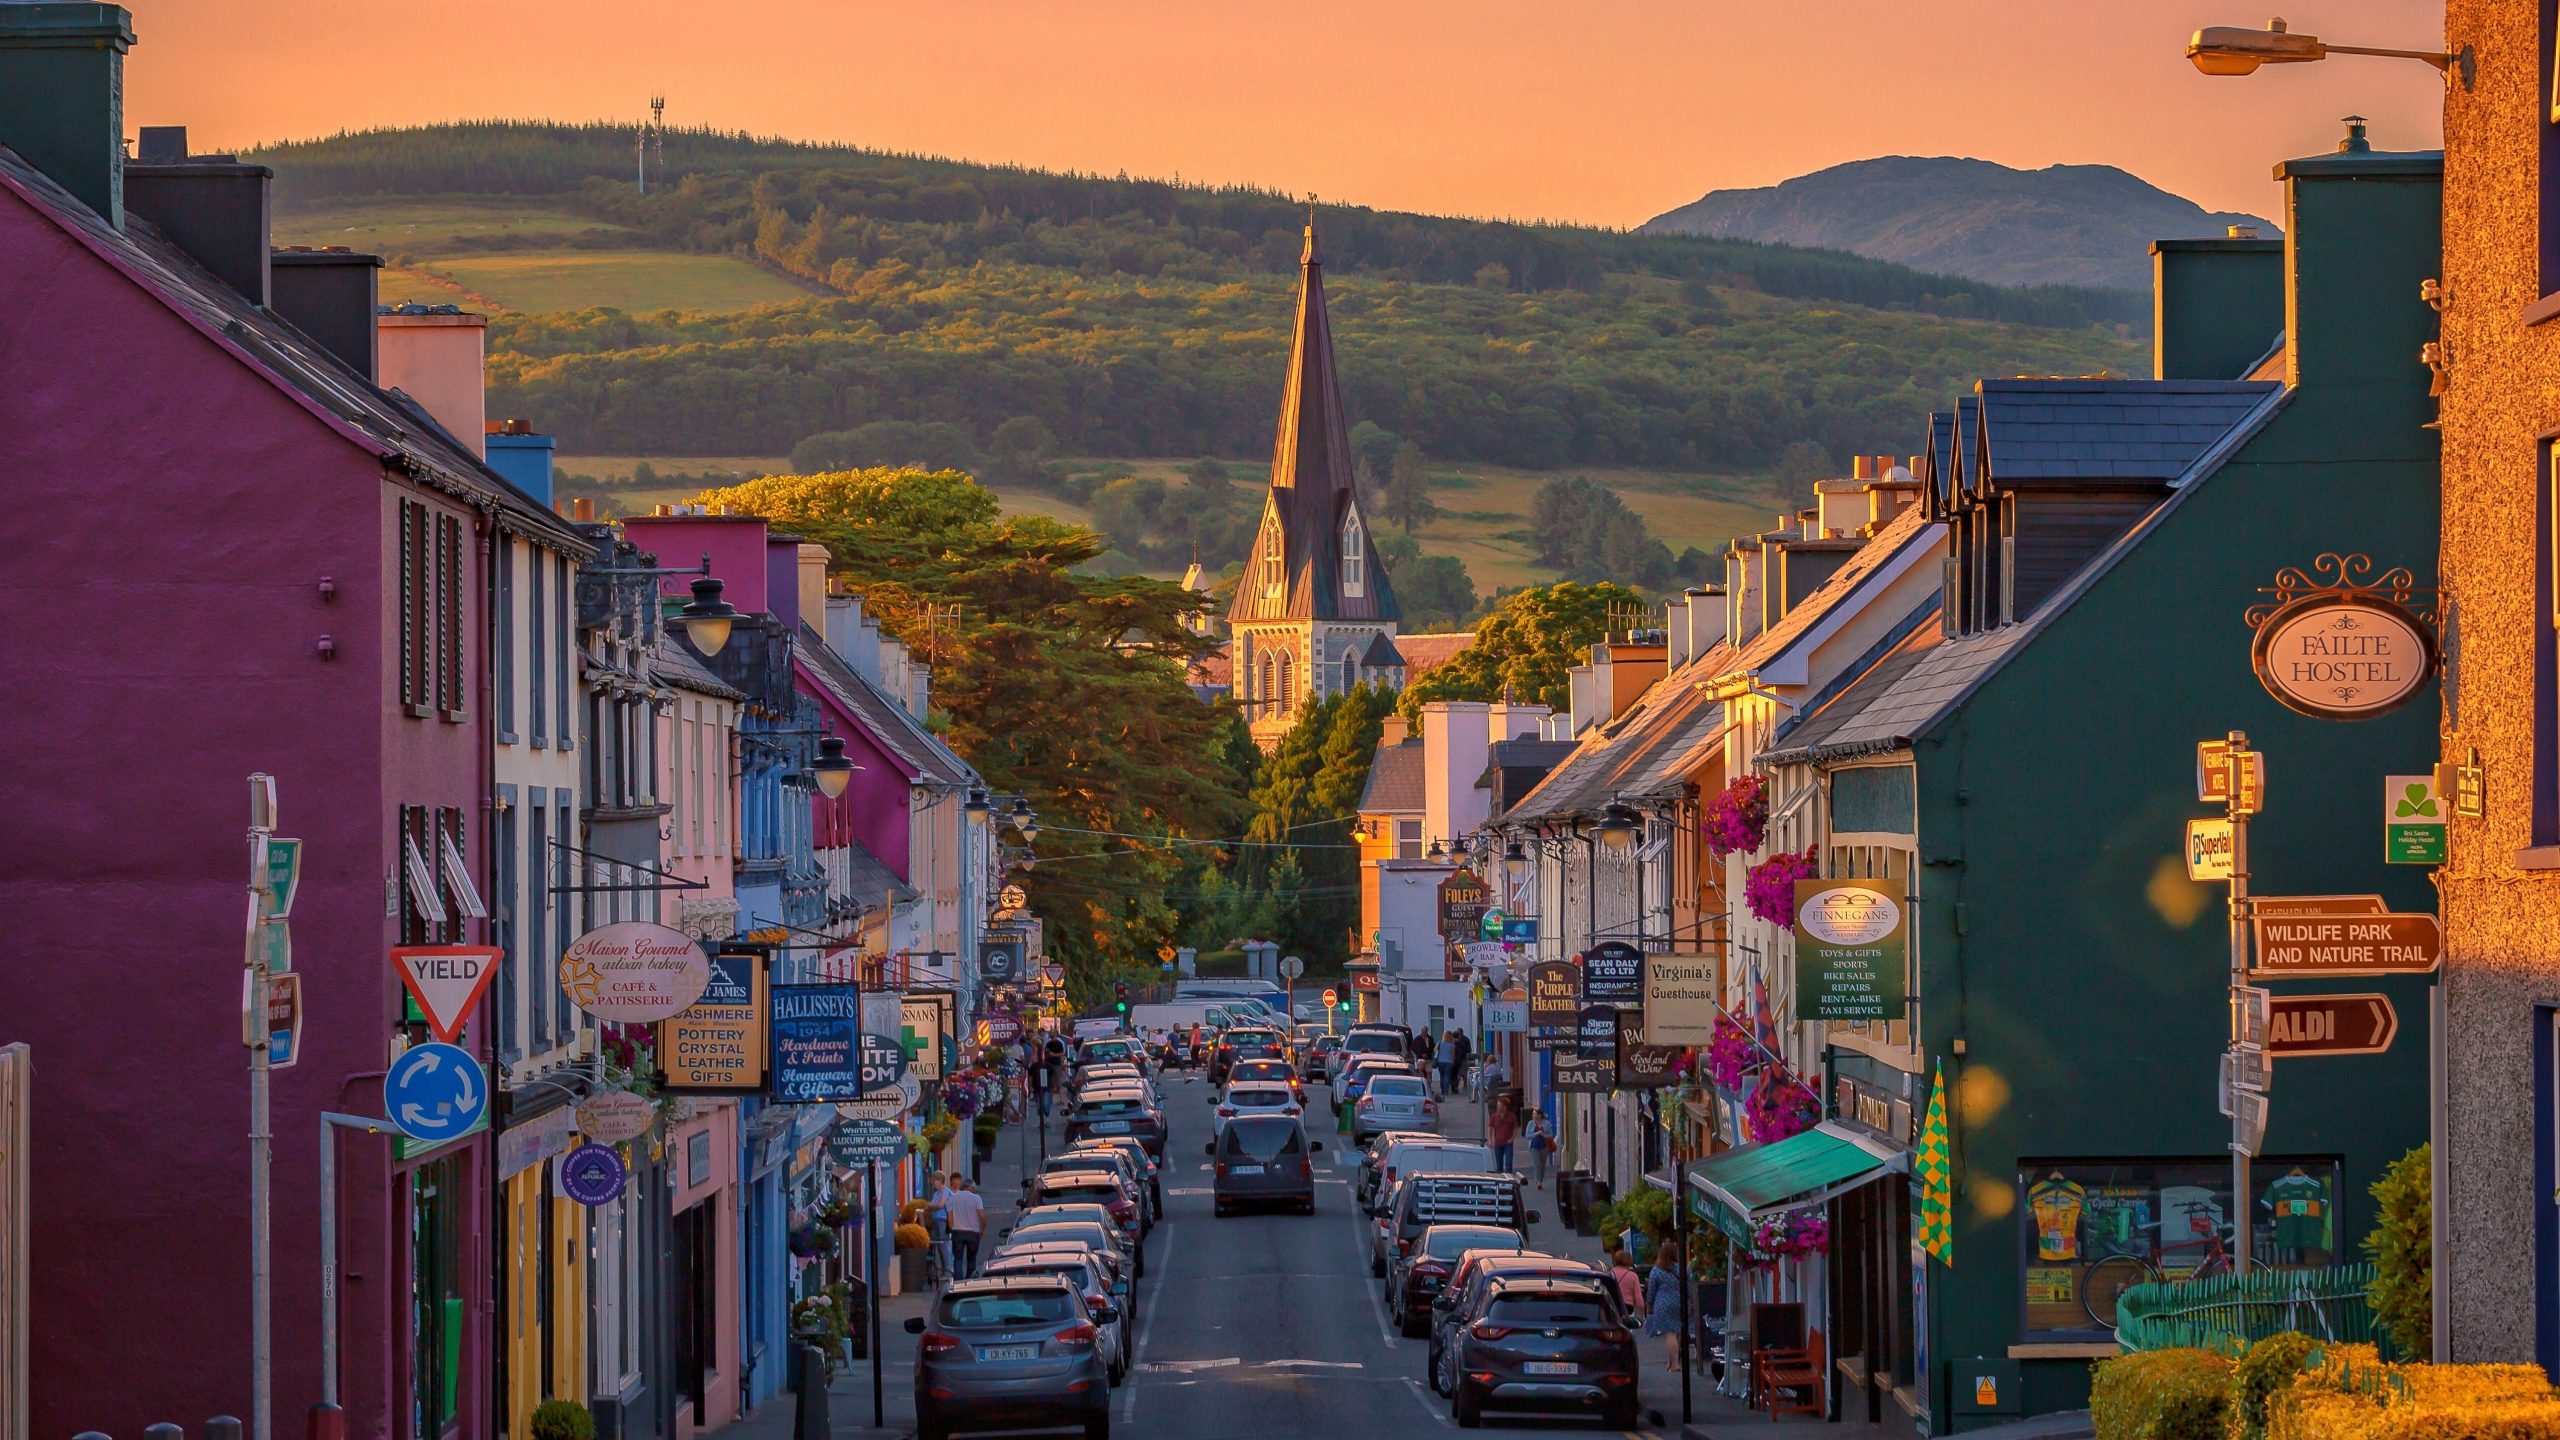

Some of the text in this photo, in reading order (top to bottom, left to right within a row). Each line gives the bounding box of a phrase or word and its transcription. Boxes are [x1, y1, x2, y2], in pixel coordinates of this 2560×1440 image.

[2302, 630, 2391, 655] FÁILTE
[2292, 662, 2400, 682] HOSTEL
[1445, 888, 1481, 903] FOLEYS
[1812, 911, 1888, 920] FINNEGANS
[2266, 924, 2392, 941] WILDLIFE PARK
[574, 938, 692, 960] Maison Gourmet
[2267, 946, 2428, 964] AND NATURE TRAIL
[414, 960, 478, 980] YIELD
[602, 957, 688, 974] artisan bakery
[1547, 971, 1563, 982] The
[1652, 964, 1712, 982] Virginia's
[612, 980, 657, 992] CAFÉ &
[713, 986, 746, 997] JAMES
[1536, 979, 1574, 996] PURPLE
[1652, 987, 1711, 999] Guesthouse
[597, 996, 673, 1005] PATISSERIE
[774, 994, 854, 1020] HALLISSEY'S
[1532, 997, 1576, 1011] HEATHER
[1587, 1019, 1614, 1028] Sherry
[2270, 1010, 2334, 1042] ALDI
[678, 1029, 745, 1040] POTTERY
[800, 1028, 830, 1037] 1954
[679, 1043, 744, 1054] CRYSTAL
[780, 1038, 849, 1051] Hardware
[678, 1057, 744, 1068] LEATHER
[787, 1051, 843, 1064] & Paints
[864, 1050, 898, 1064] ITE
[691, 1071, 733, 1082] GIFTS
[782, 1069, 853, 1082] Homeware
[862, 1067, 895, 1082] OM
[1558, 1071, 1598, 1084] BAR
[785, 1081, 833, 1098] & Gifts
[856, 1110, 886, 1118] SHOP
[867, 1136, 902, 1144] HOLIDAY
[842, 1146, 894, 1154] APARTMENTS
[2092, 1199, 2115, 1208] Cycle
